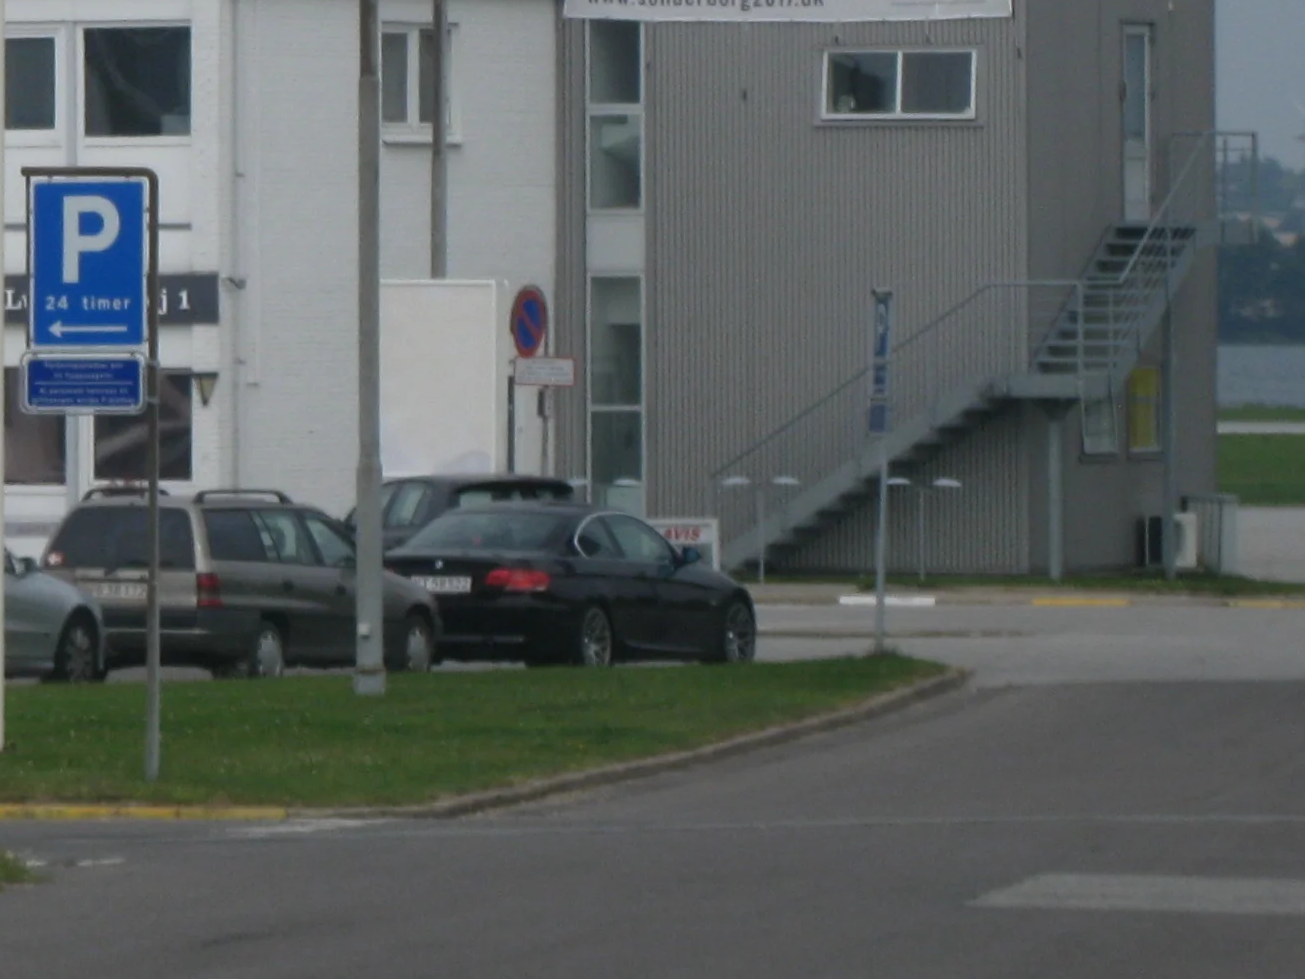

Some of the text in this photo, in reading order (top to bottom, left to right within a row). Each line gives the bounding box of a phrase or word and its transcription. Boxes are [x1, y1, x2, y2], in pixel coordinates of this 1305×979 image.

[62, 194, 121, 284] P
[44, 295, 69, 311] 24
[81, 295, 132, 311] timer
